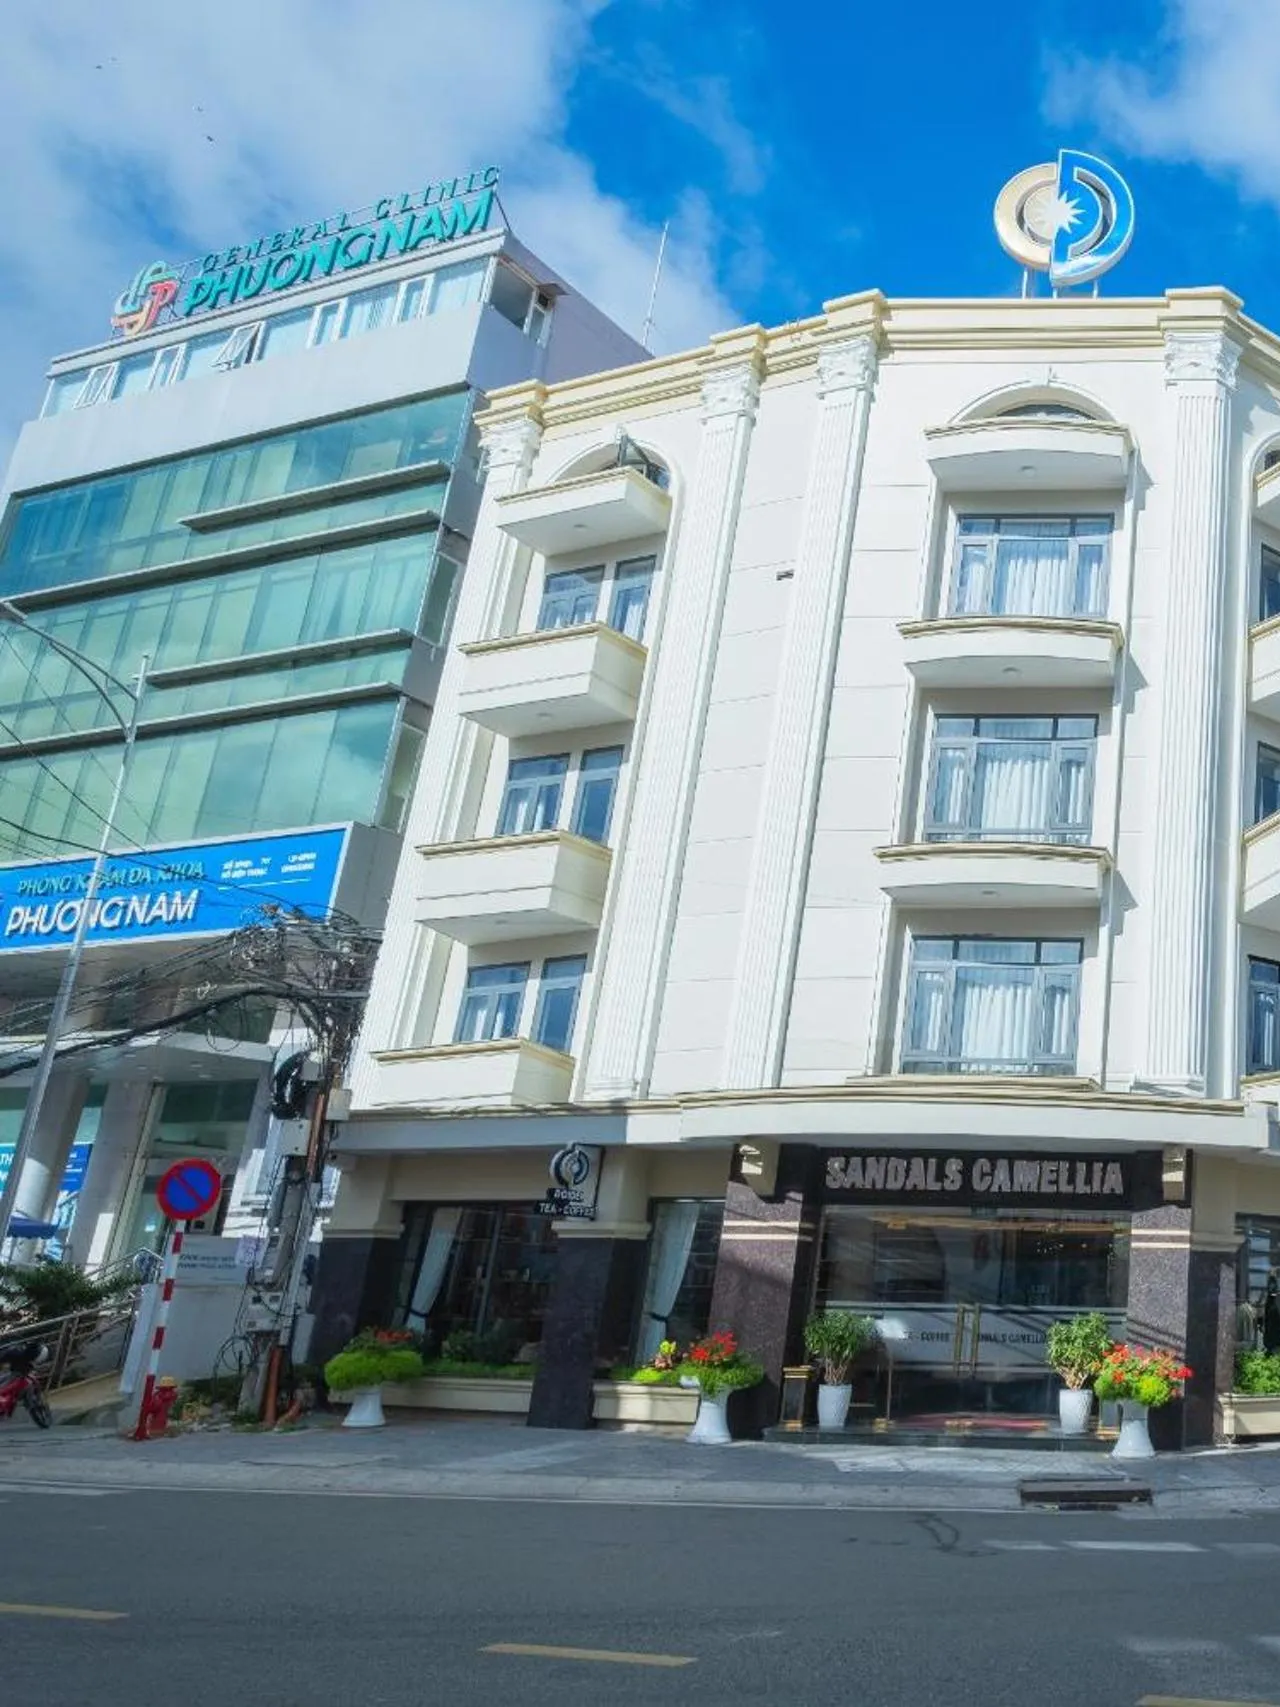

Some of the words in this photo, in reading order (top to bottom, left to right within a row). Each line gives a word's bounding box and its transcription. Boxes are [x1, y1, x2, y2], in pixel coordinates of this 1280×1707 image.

[202, 211, 350, 273] GENERAL
[376, 166, 499, 220] CLINIC
[826, 1156, 963, 1191] SANDALS
[971, 1158, 1125, 1196] CAMELLIA
